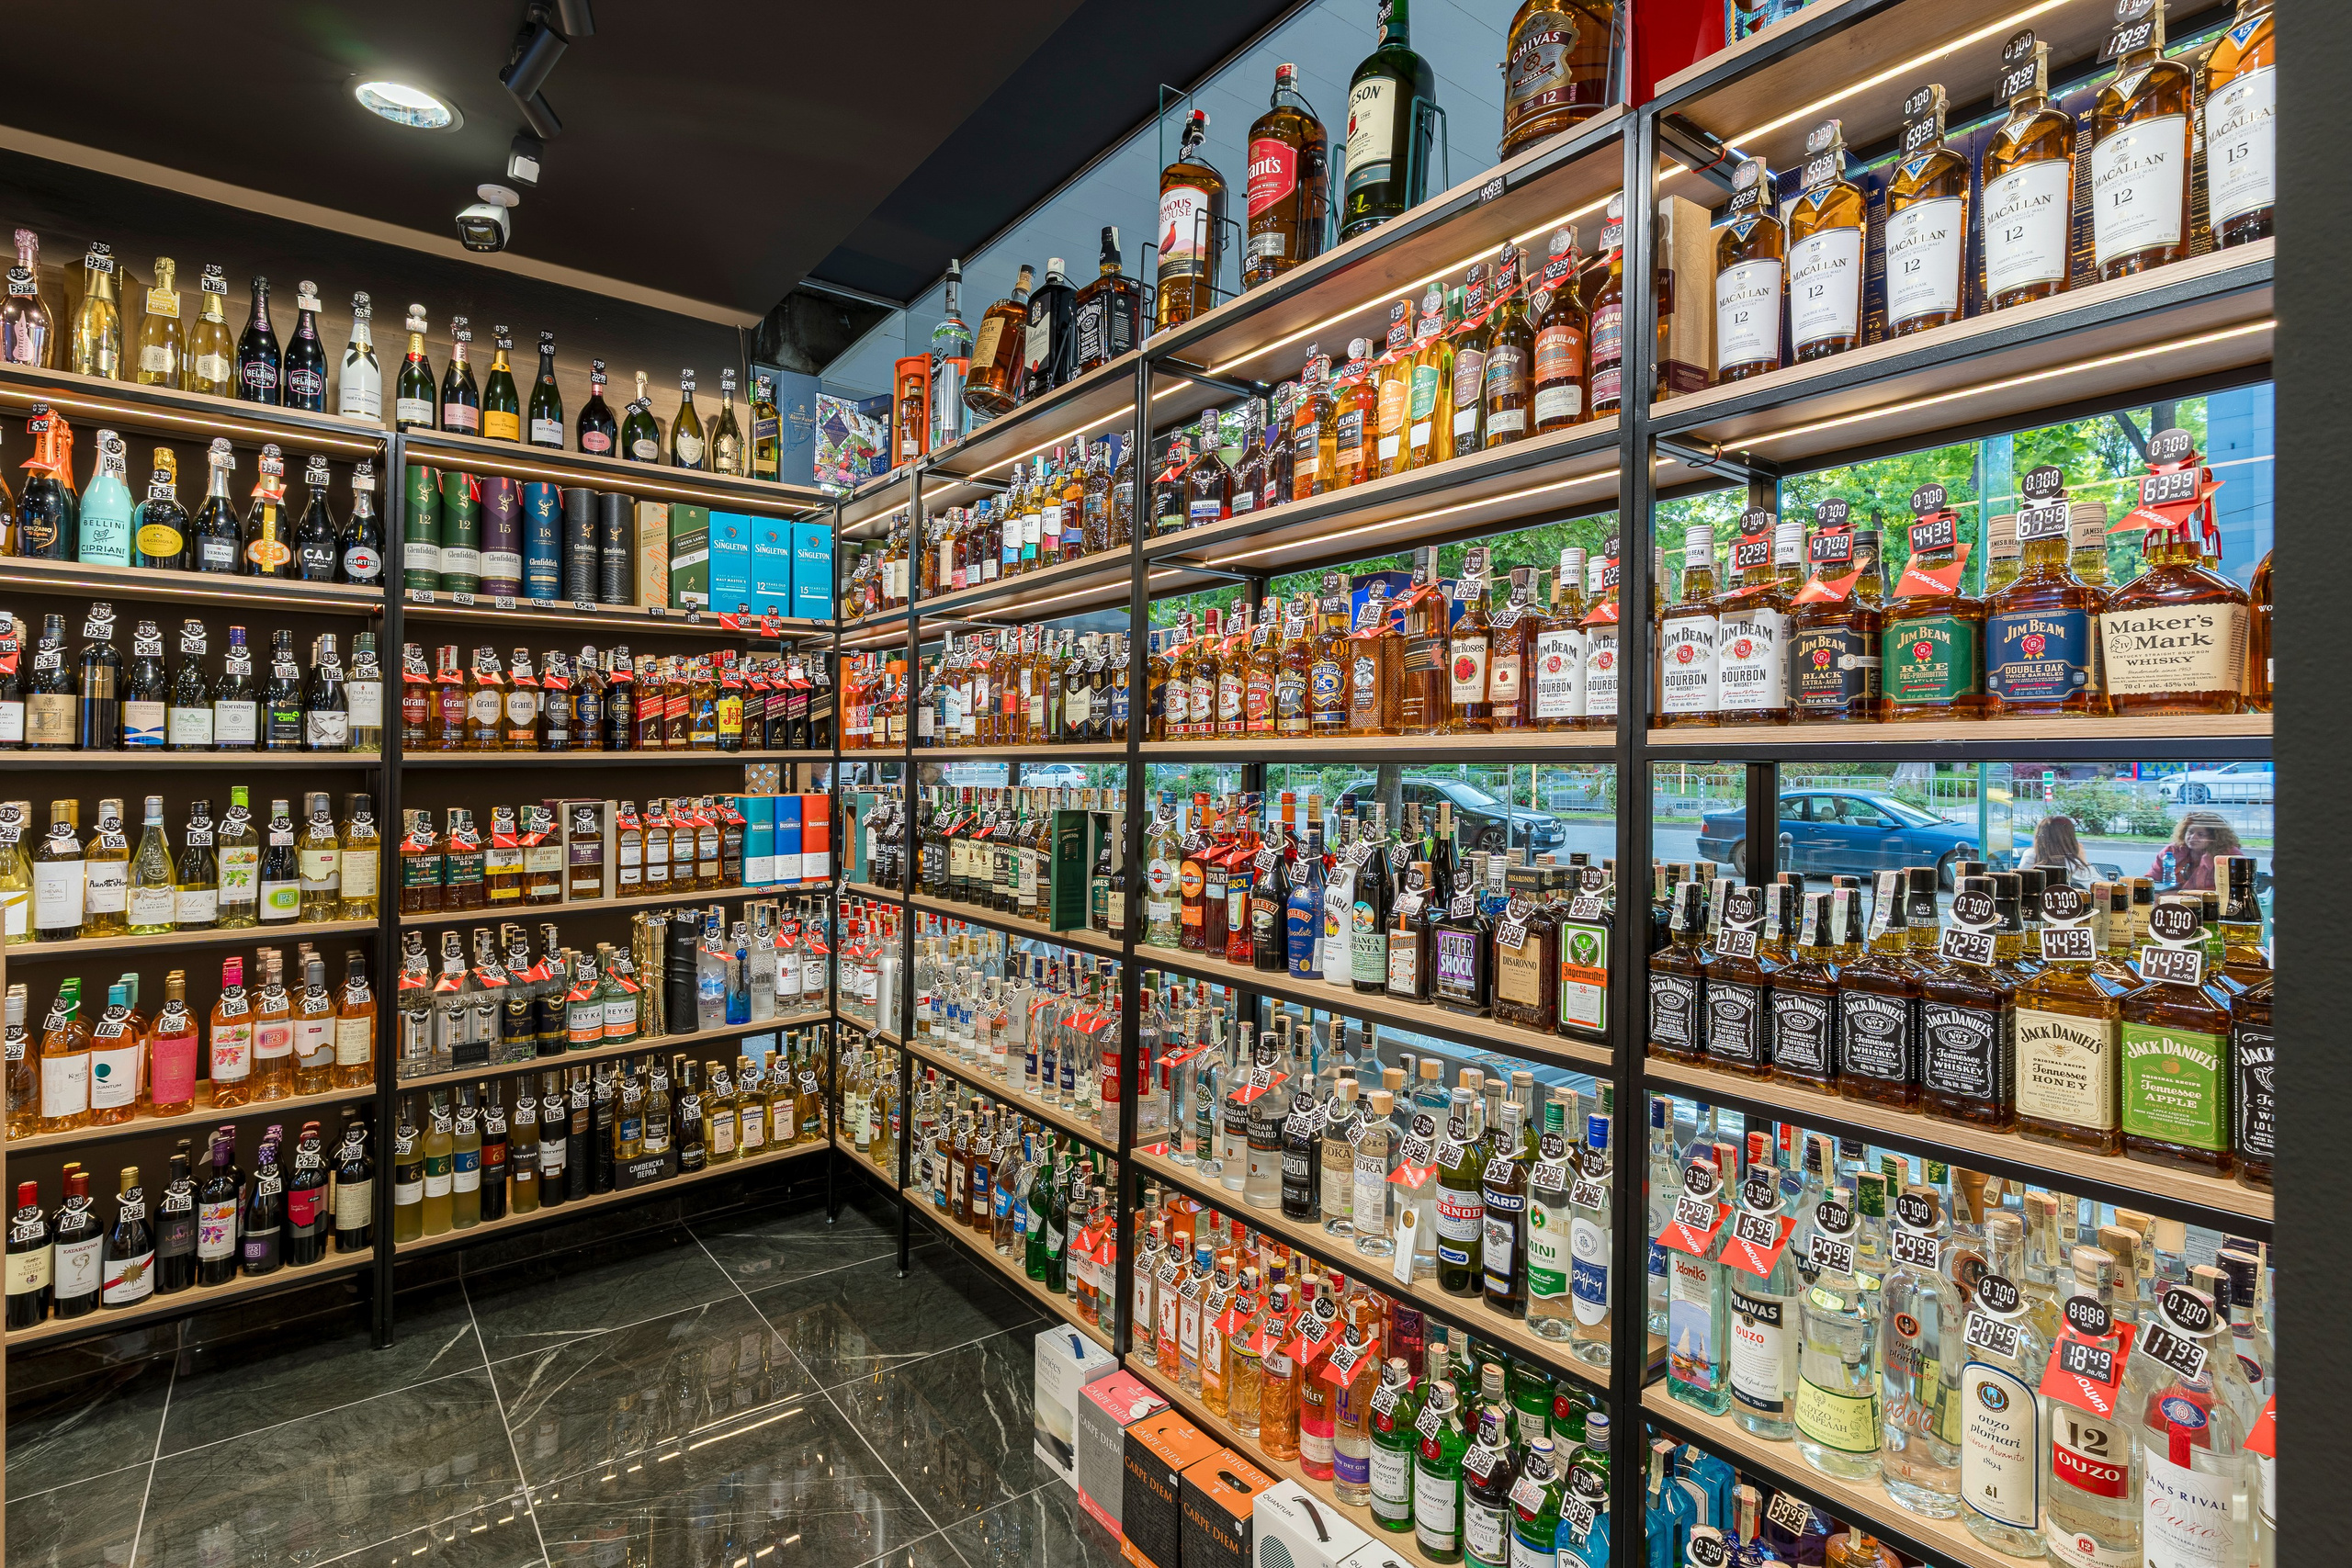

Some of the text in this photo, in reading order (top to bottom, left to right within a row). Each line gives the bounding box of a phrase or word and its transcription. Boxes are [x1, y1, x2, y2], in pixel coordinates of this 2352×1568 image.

[2238, 24, 2252, 37] 15
[1512, 31, 1561, 64] CHIVAS
[1521, 71, 1543, 85] REGAL
[1349, 86, 1381, 109] ESON
[1542, 91, 1557, 105] 12
[2228, 106, 2245, 121] The
[2208, 107, 2276, 146] MACALLA
[2112, 153, 2130, 167] The
[2227, 142, 2249, 164] 15
[2095, 153, 2167, 189] MACALLAN
[2006, 193, 2021, 205] The
[2113, 188, 2133, 208] 12
[1987, 194, 2053, 225] MACALLAN
[2006, 226, 2024, 243] 12
[1888, 230, 1948, 257] MACALLAN
[1792, 258, 1848, 282] MACALLAN
[1904, 258, 1921, 274] 12
[1808, 285, 1824, 299] 12
[247, 370, 275, 381] BELAIRE
[1339, 413, 1361, 427] JURA
[84, 521, 125, 529] BELLINI
[419, 514, 431, 524] 12
[499, 524, 511, 533] 15
[539, 528, 551, 537] 18
[265, 521, 275, 569] CHANDON
[693, 535, 707, 543] LABEL
[714, 540, 748, 551] SINGLETON
[81, 545, 125, 554] CIPRIANI
[303, 549, 333, 561] CAJ
[407, 547, 437, 556] Glenfiddich
[798, 549, 830, 559] SINGLETON
[347, 558, 377, 567] MARTINI
[489, 555, 517, 563] Glenfiddich
[529, 558, 558, 567] Glenfiddich
[1905, 570, 1952, 593] ПРОМОЦИЯ
[2004, 619, 2066, 644] JIM BEAM
[2109, 615, 2213, 635] Maker's
[1663, 627, 1713, 651] JIM BEAM
[1720, 621, 1773, 647] JIM BEAM
[1897, 627, 1951, 649] JIM BEAM
[2134, 632, 2212, 649] Mark
[1462, 644, 1484, 653] Roses
[1799, 636, 1846, 657] JIM BEAM
[1900, 662, 1949, 672] RYE
[2006, 664, 2042, 673] DOUBLE
[2126, 656, 2194, 666] WHISKY
[1323, 667, 1342, 676] REGAL
[1722, 670, 1766, 682] BOURBON
[1281, 689, 1292, 702] XV
[219, 703, 254, 711] Thornbury
[724, 707, 742, 725] J&B
[1149, 872, 1170, 880] MARTINI
[1508, 874, 1535, 883] DISARONNO
[1324, 895, 1351, 914] ALIBU
[1390, 937, 1416, 949] COINTREAU
[1441, 935, 1474, 956] AFTER
[1441, 955, 1474, 976] SHOCK
[1502, 956, 1536, 970] DISARONNO
[1564, 965, 1605, 982] Jägermeister
[1579, 985, 1587, 993] 56
[572, 1011, 601, 1020] REYKA
[606, 1007, 634, 1015] REYKA
[1844, 998, 1907, 1024] JACK DANIEL'S
[1926, 1011, 1995, 1038] JACK DANIEL'S
[2020, 1022, 2104, 1055] JACK DANIEL'S
[1937, 1047, 1981, 1064] Tennessee
[2127, 1037, 2220, 1072] JACK DANIEL'S
[1933, 1060, 1984, 1076] WHISKEY
[2032, 1063, 2087, 1082] Tennessee
[2032, 1074, 2087, 1091] HONEY
[2142, 1074, 2174, 1083] ORIGINAL
[2141, 1079, 2202, 1100] Tennessee
[2144, 1093, 2197, 1109] APPLE
[629, 1160, 664, 1176] СЛИВЕНСКА
[639, 1168, 657, 1180] ПЕРЛА
[63, 1243, 97, 1254] KATARZYNA
[1739, 1237, 1768, 1275] РОМОЦИЯ
[1684, 1278, 1699, 1286] OUZO
[1731, 1292, 1778, 1319] PILAVAS
[1736, 1325, 1765, 1344] OUZO
[1895, 1340, 1921, 1355] ouzo
[1889, 1348, 1930, 1370] plomari
[1885, 1393, 1935, 1432] adolo
[1978, 1414, 2010, 1432] ouzo
[1080, 1413, 1120, 1456] CARPE DIEM
[1970, 1424, 2021, 1450] plomari
[2067, 1420, 2109, 1458] 12
[1982, 1456, 2002, 1472] 1894
[2058, 1453, 2120, 1482] OUZO
[1125, 1456, 1172, 1504] CARPE DIEM
[1373, 1467, 1396, 1480] LONDON
[2144, 1471, 2228, 1512] SANS RIVAL
[1262, 1494, 1294, 1517] QUANTUM
[2150, 1497, 2218, 1537] Ouzo
[1183, 1503, 1238, 1554] CARPE DIEM
